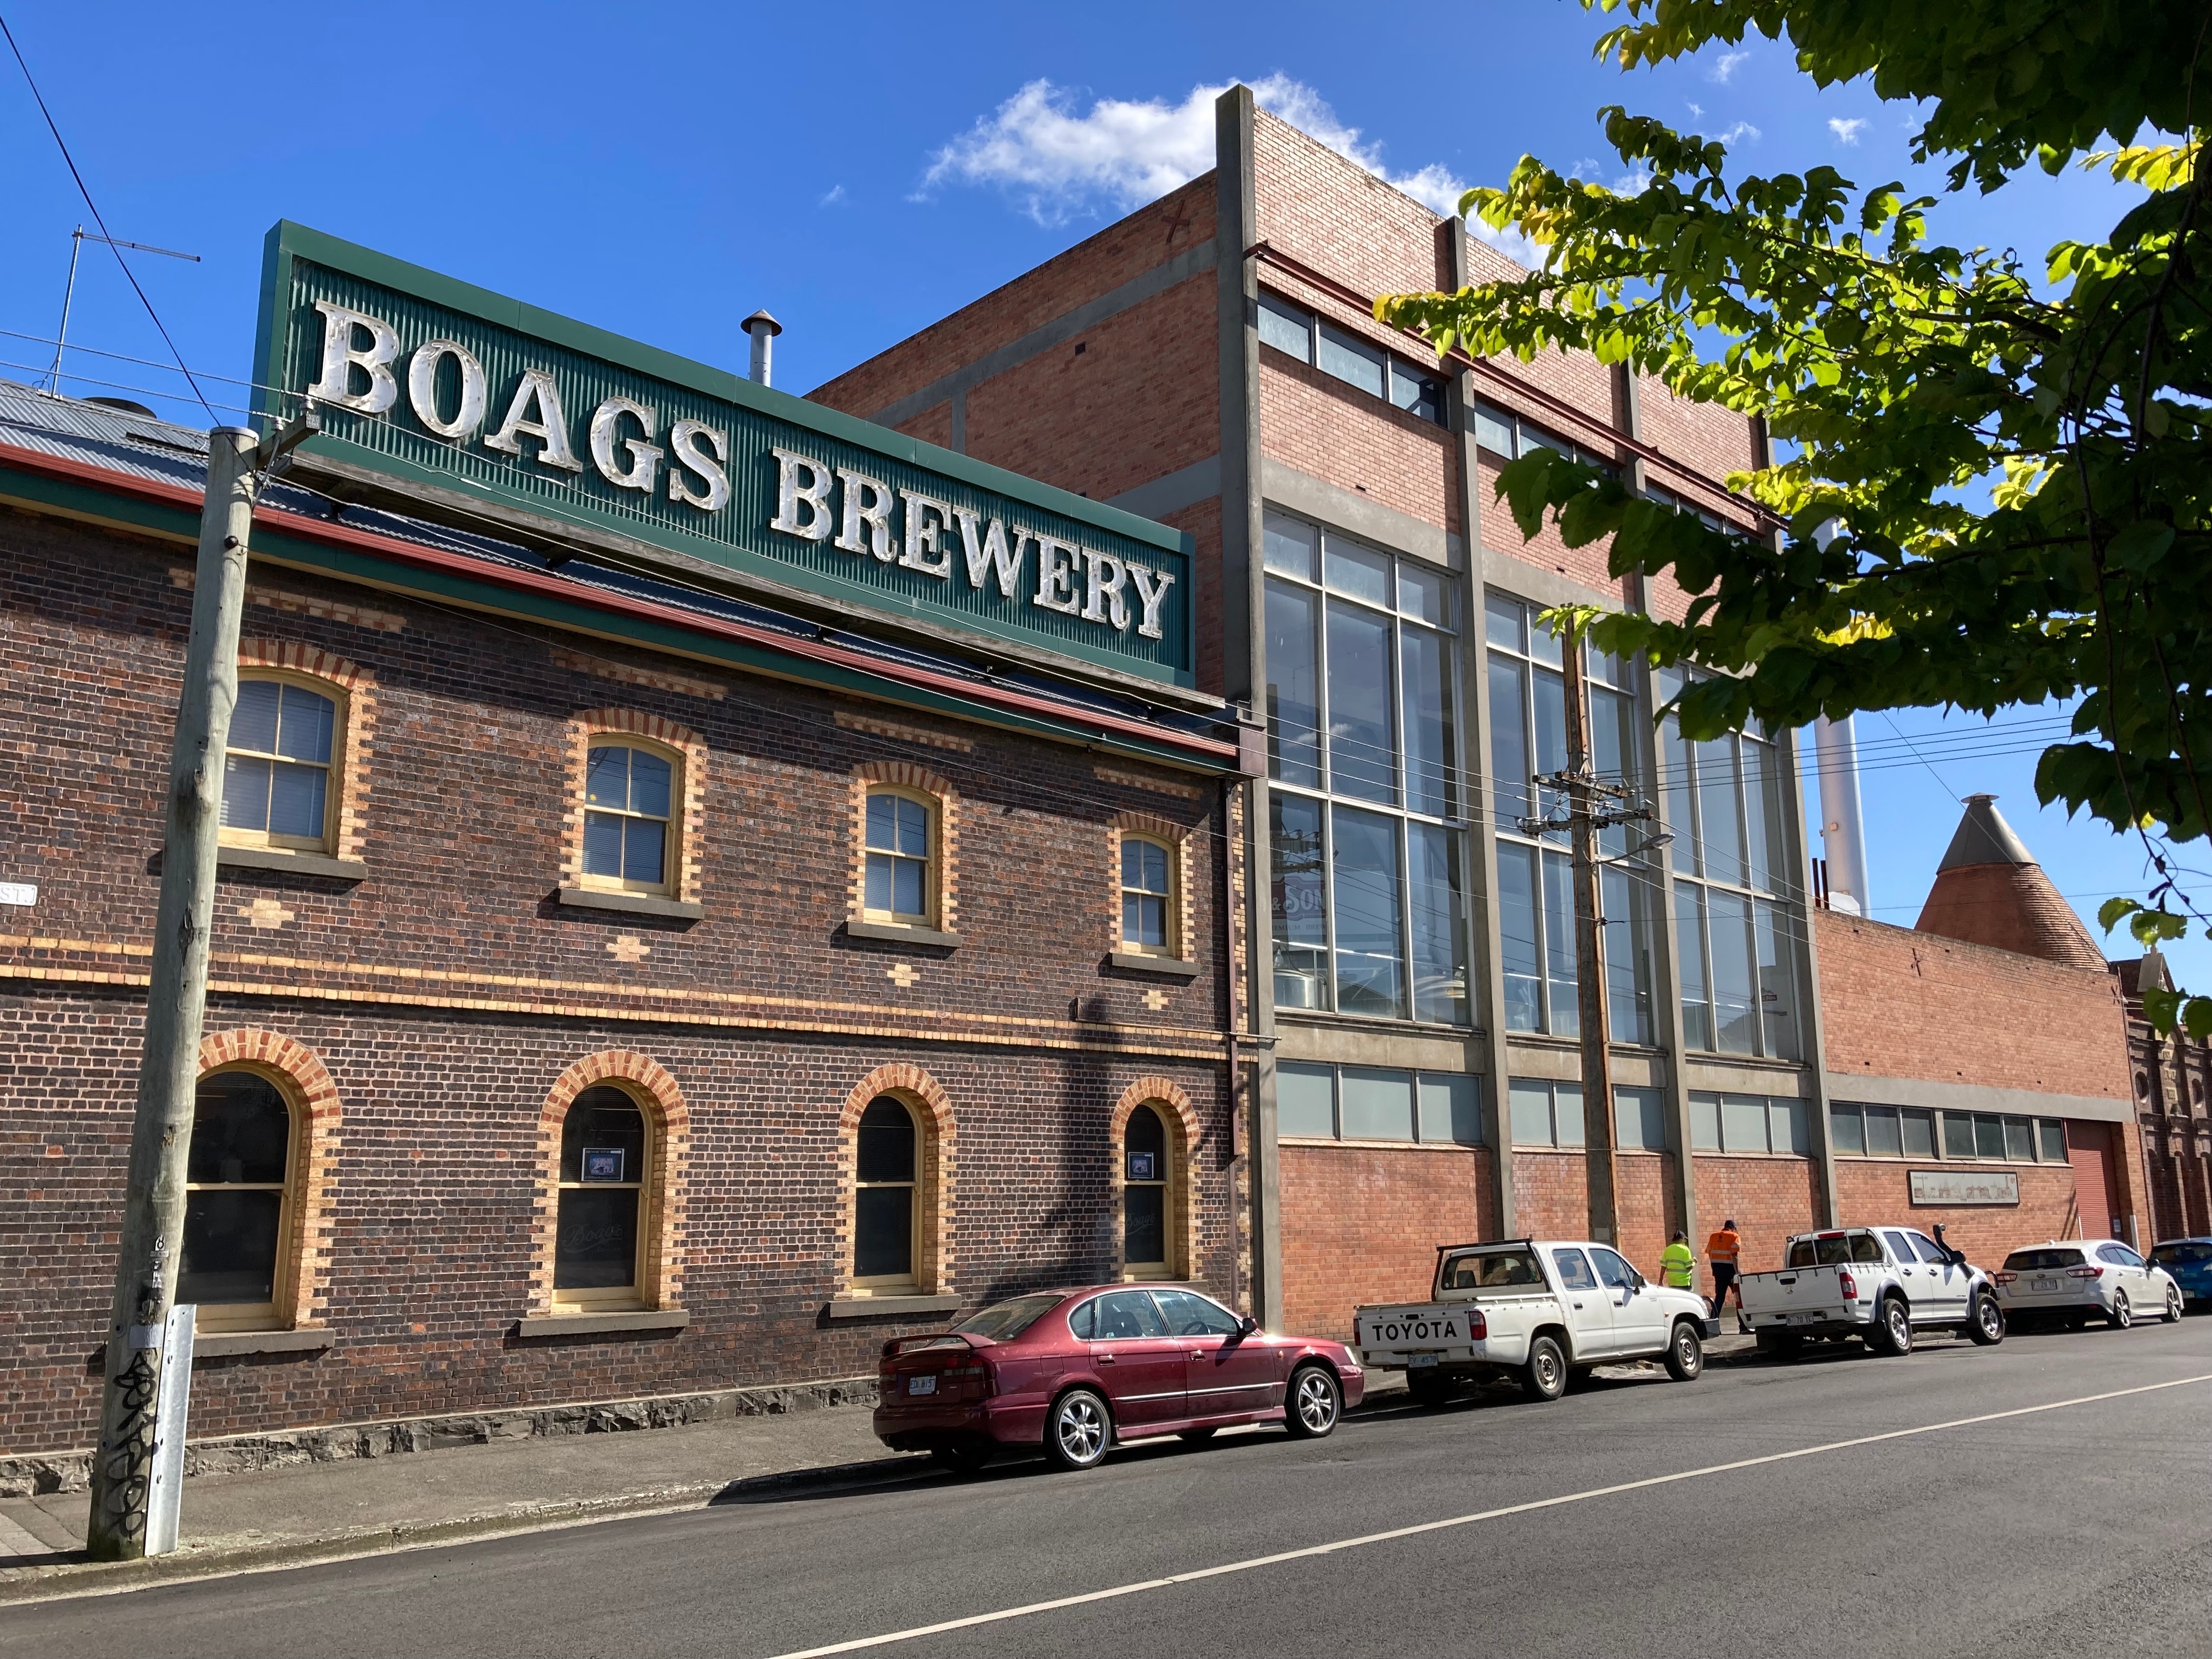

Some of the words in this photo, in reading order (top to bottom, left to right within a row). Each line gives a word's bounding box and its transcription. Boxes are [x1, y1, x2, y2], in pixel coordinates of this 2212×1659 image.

[308, 299, 730, 512] BOAGS
[771, 447, 1175, 639] BREWERY
[1272, 898, 1281, 911] &
[1372, 1321, 1457, 1341] TOYOTA
[921, 1379, 936, 1389] 6157
